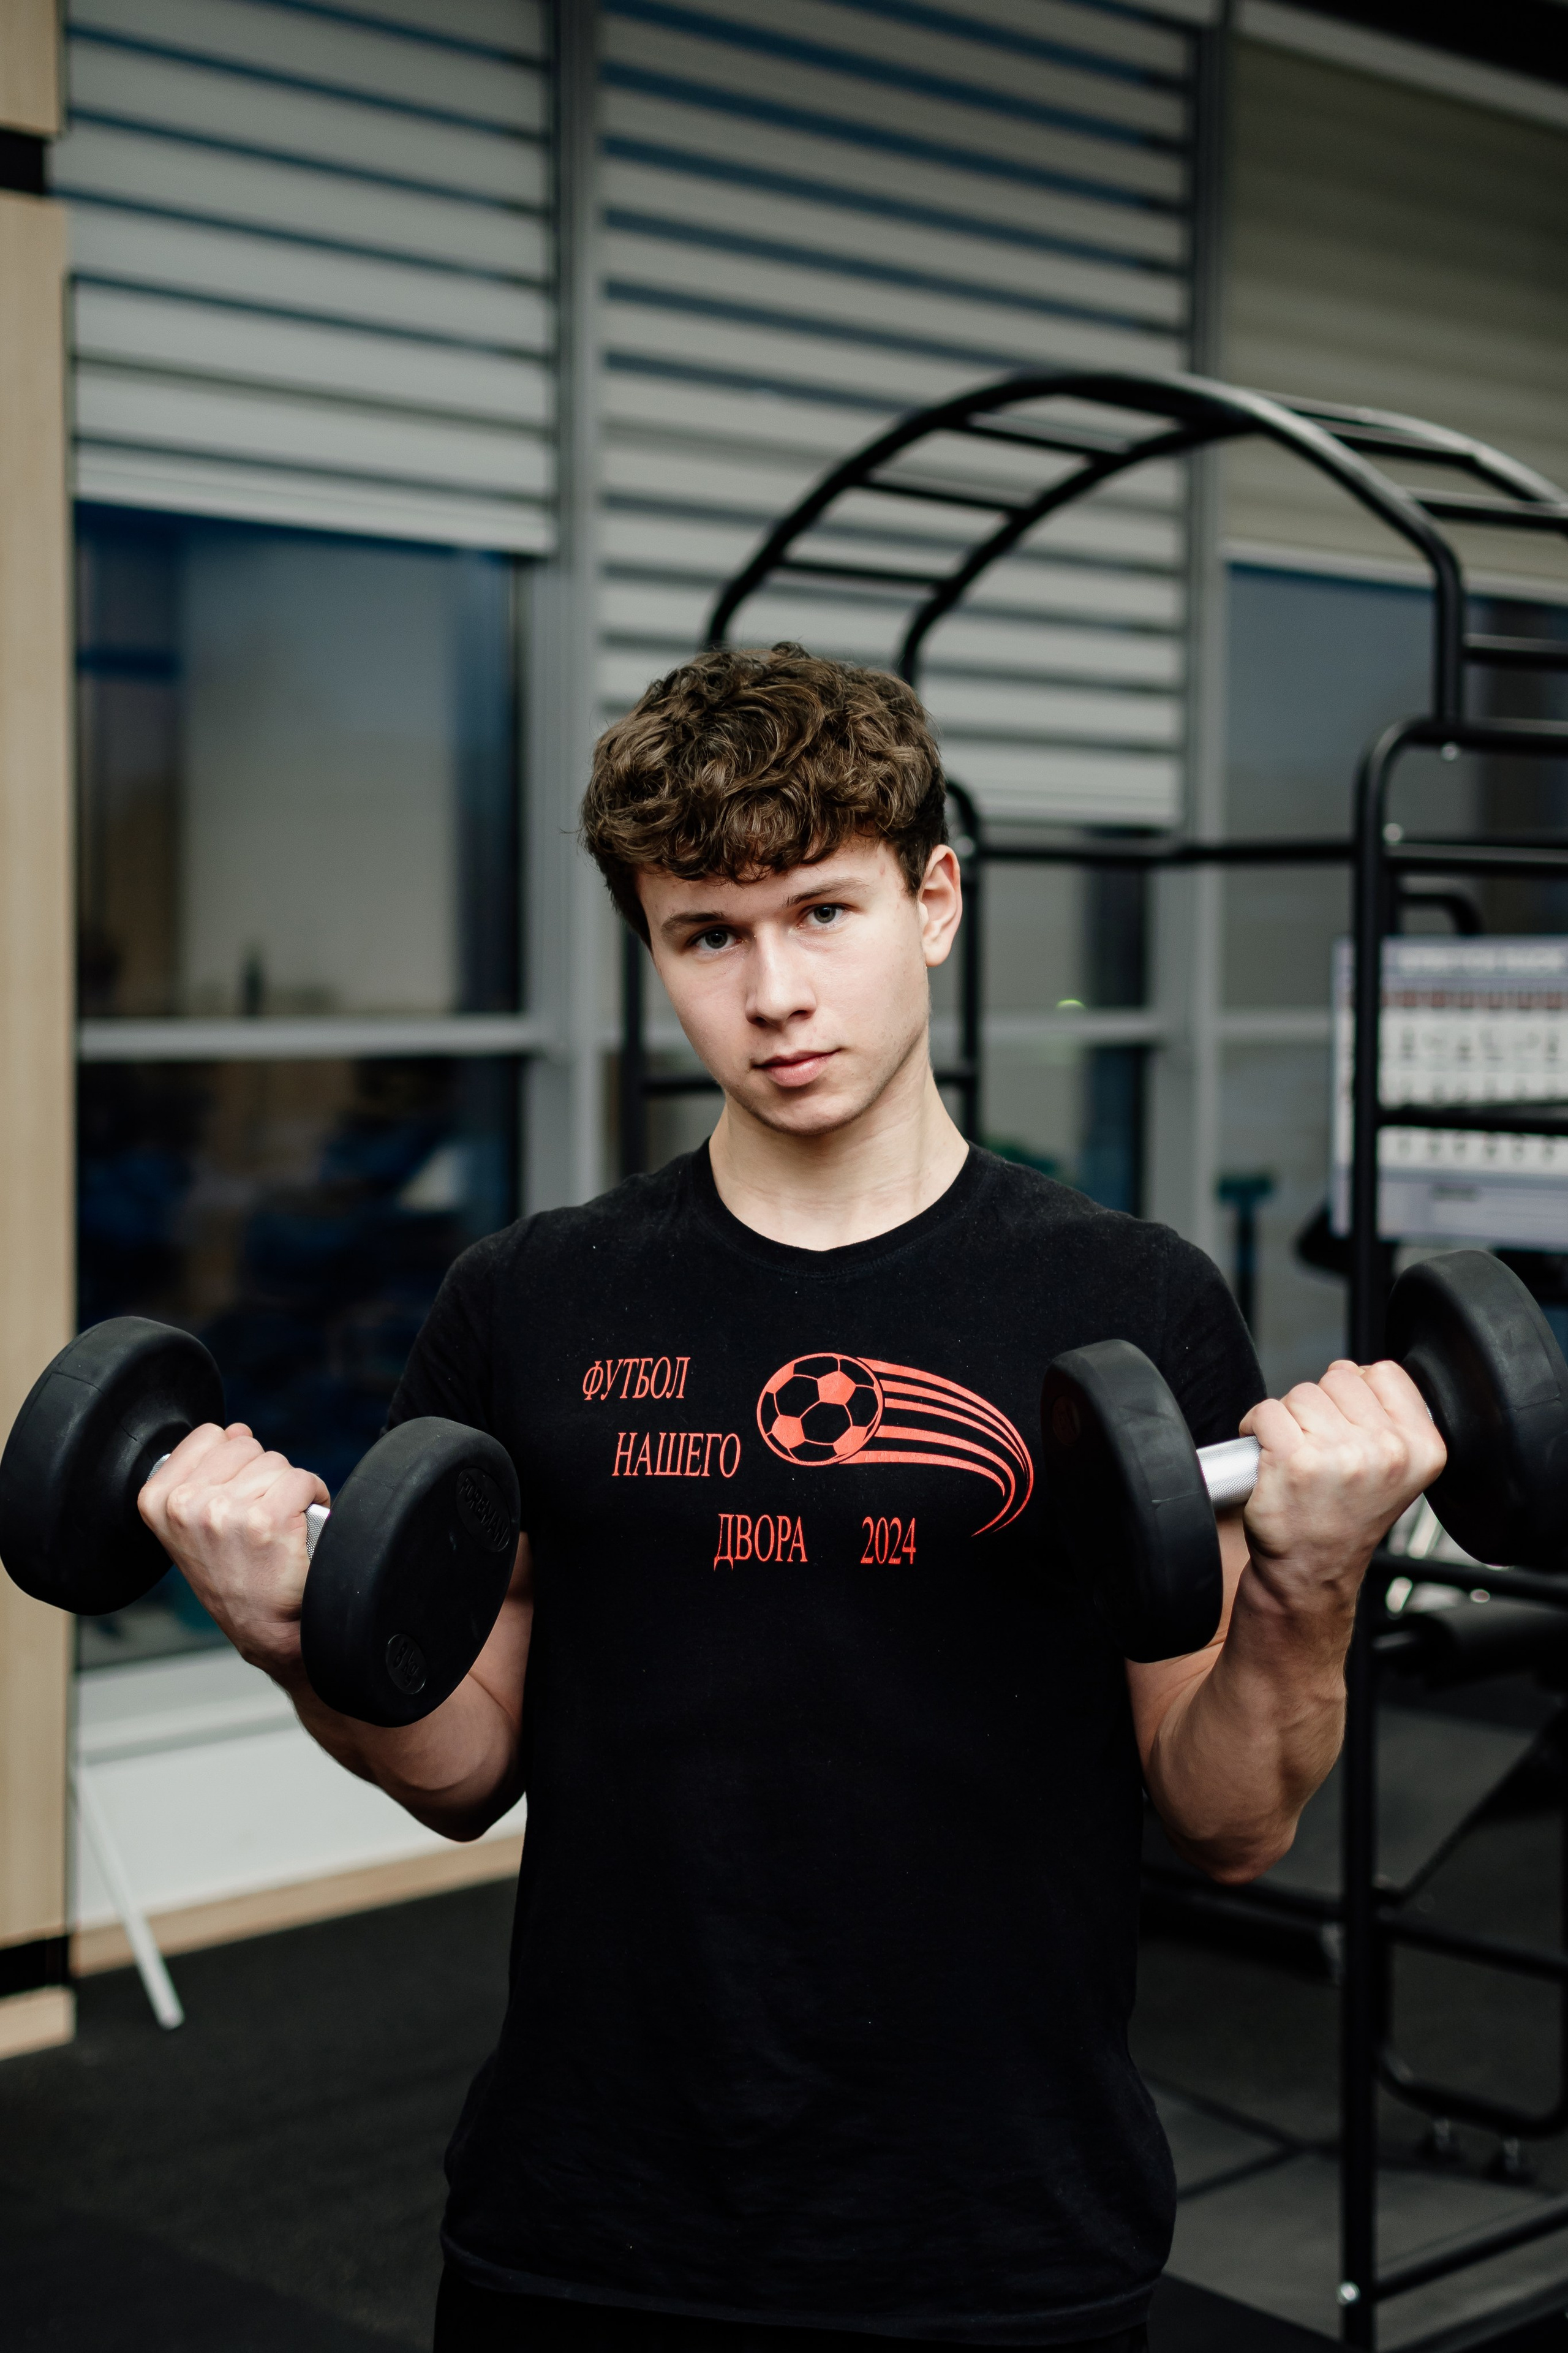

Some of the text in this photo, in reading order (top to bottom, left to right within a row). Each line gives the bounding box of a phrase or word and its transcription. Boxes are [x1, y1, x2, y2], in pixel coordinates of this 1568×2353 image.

[582, 1356, 690, 1400] ФУТБОЛ
[612, 1432, 741, 1478] НАШЕГО
[460, 1475, 508, 1546] FOREMAN
[714, 1514, 916, 1570] ДВОРА 2024
